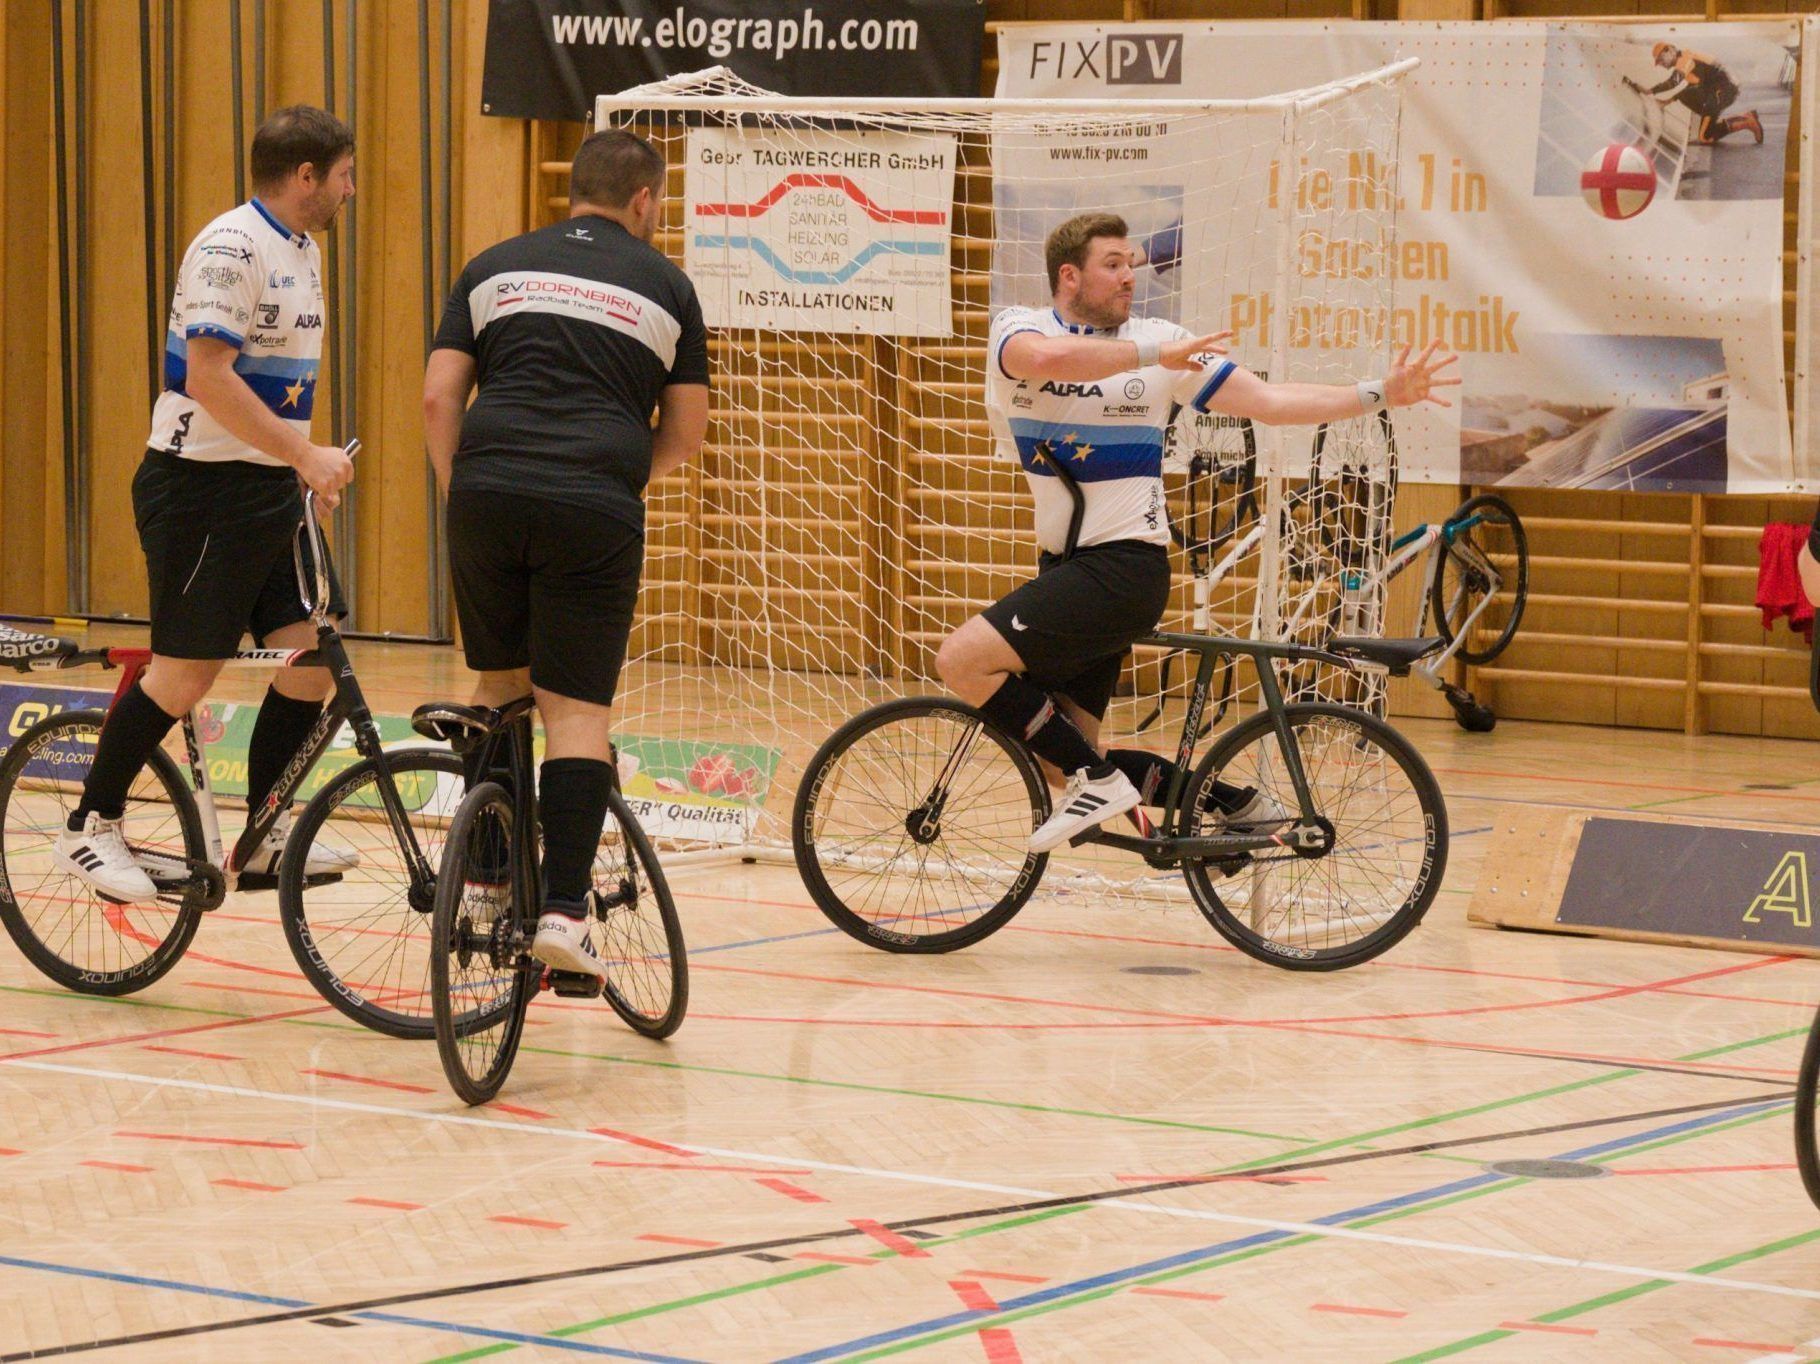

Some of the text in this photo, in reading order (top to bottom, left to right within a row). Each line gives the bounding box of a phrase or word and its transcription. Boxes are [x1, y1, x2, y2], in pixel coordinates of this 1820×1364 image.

[552, 7, 918, 60] www.elograph.com
[888, 153, 944, 170] GmbH
[1050, 146, 1148, 162] www.fix-pv.com
[1418, 153, 1436, 212] 1
[1450, 158, 1488, 213] in
[788, 231, 849, 246] HEIZUNG
[1297, 227, 1449, 281] Sachen
[571, 299, 604, 313] Team
[738, 290, 894, 312] INSTALLATIONEN
[1039, 380, 1104, 398] ALPLA
[803, 753, 838, 847] EQUINOX
[667, 802, 743, 826] Qualität
[1406, 813, 1436, 910] EQUINOX
[78, 954, 157, 985] EQUINOX
[295, 916, 364, 1007] EQUINOX
